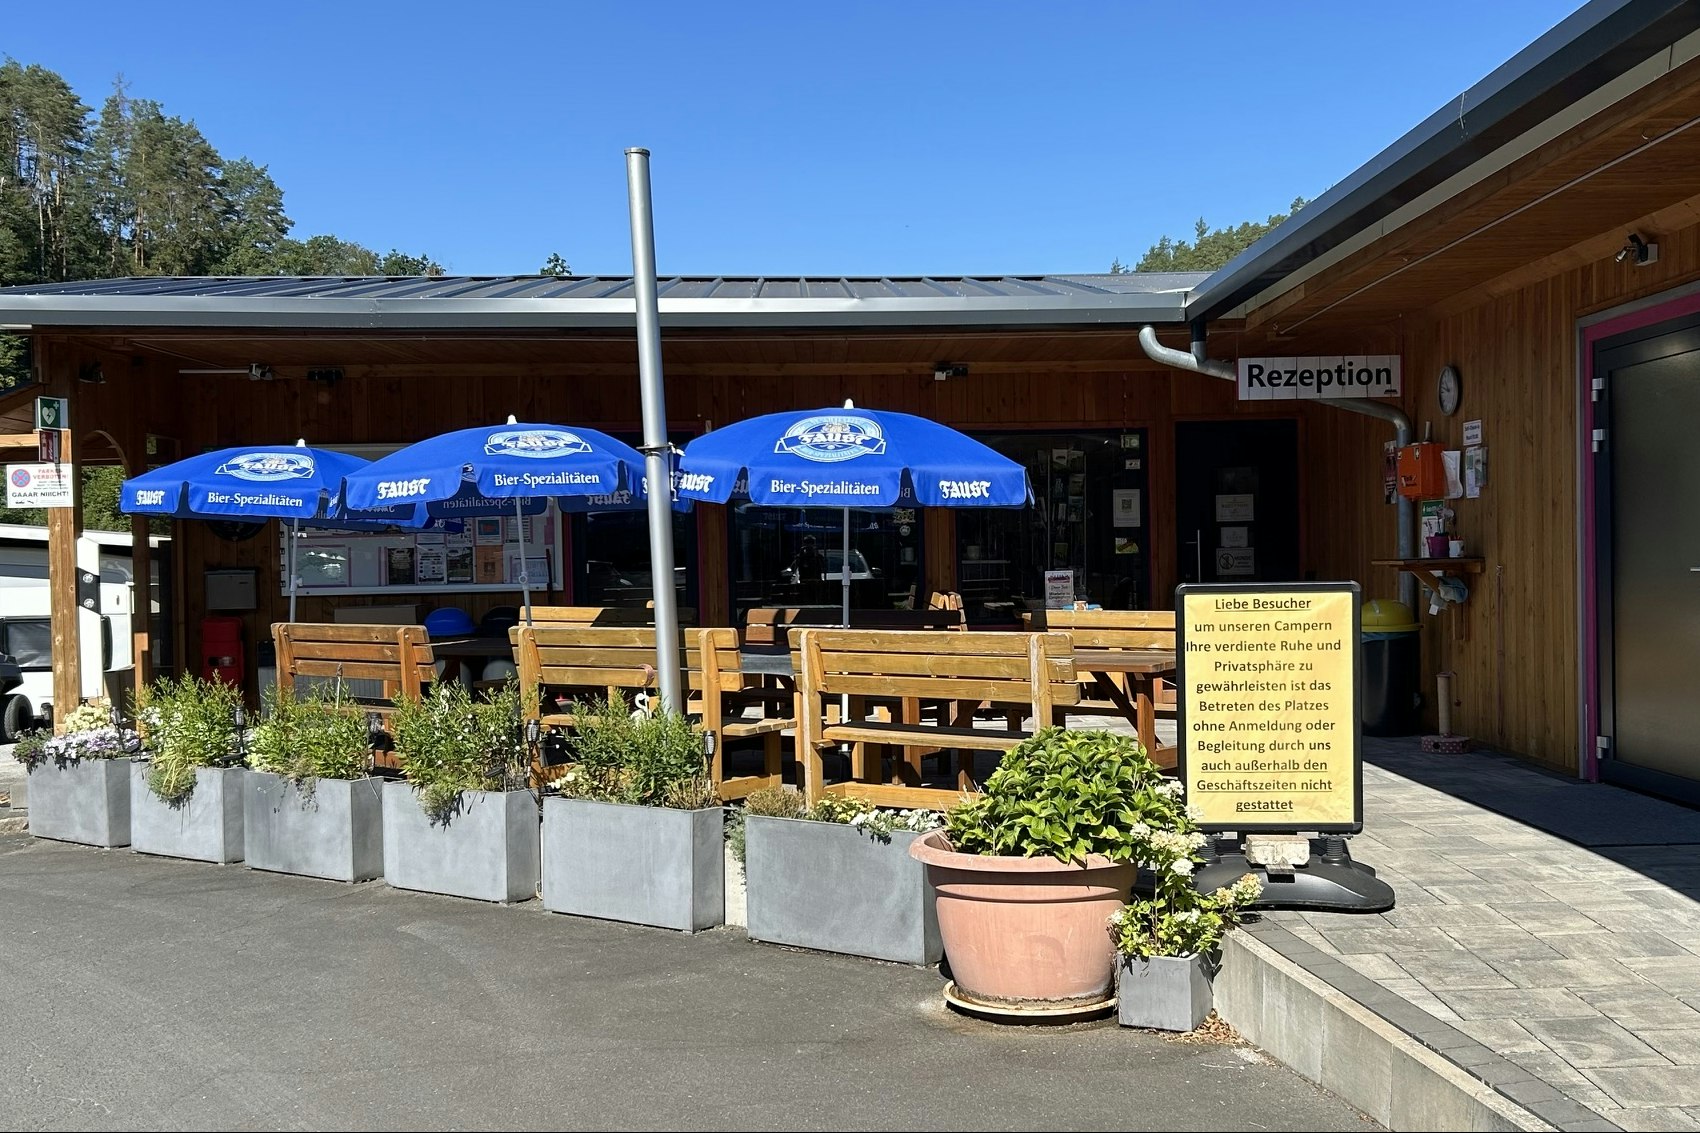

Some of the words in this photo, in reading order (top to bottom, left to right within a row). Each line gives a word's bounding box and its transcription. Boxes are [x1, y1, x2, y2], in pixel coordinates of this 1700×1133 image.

[1247, 361, 1392, 393] Rezeption
[494, 473, 600, 489] Bier-Spezialitäten
[770, 479, 880, 497] Bier-Spezialitäten
[208, 492, 303, 507] Bier-Spezialitäten
[1215, 598, 1249, 610] Liebe
[1252, 598, 1312, 609] Besucher
[1194, 623, 1215, 632] um
[1219, 622, 1270, 632] unseren
[1274, 620, 1332, 633] Campern
[1186, 641, 1211, 652] Ihre
[1214, 640, 1276, 651] verdiente
[1280, 640, 1313, 651] Ruhe
[1316, 639, 1341, 650] und
[1214, 660, 1295, 674] Privatsphäre
[1298, 662, 1313, 671] zu
[1196, 680, 1287, 694] gewährleisten
[1290, 680, 1306, 691] ist
[1309, 680, 1332, 690] das
[1199, 701, 1255, 712] Betreten
[1258, 700, 1281, 711] des
[1284, 700, 1329, 711] Platzes
[1193, 721, 1225, 731] ohne
[1228, 720, 1302, 733] Anmeldung
[1305, 720, 1336, 731] oder
[1197, 740, 1265, 753] Begleitung
[1269, 739, 1305, 751] durch
[1309, 741, 1331, 751] uns
[1201, 760, 1231, 771] auch
[1235, 759, 1300, 771] außerhalb
[1303, 759, 1328, 770] den
[1196, 779, 1297, 791] Geschäftszeiten
[1300, 779, 1333, 790] nicht
[1236, 800, 1294, 812] gestattet
